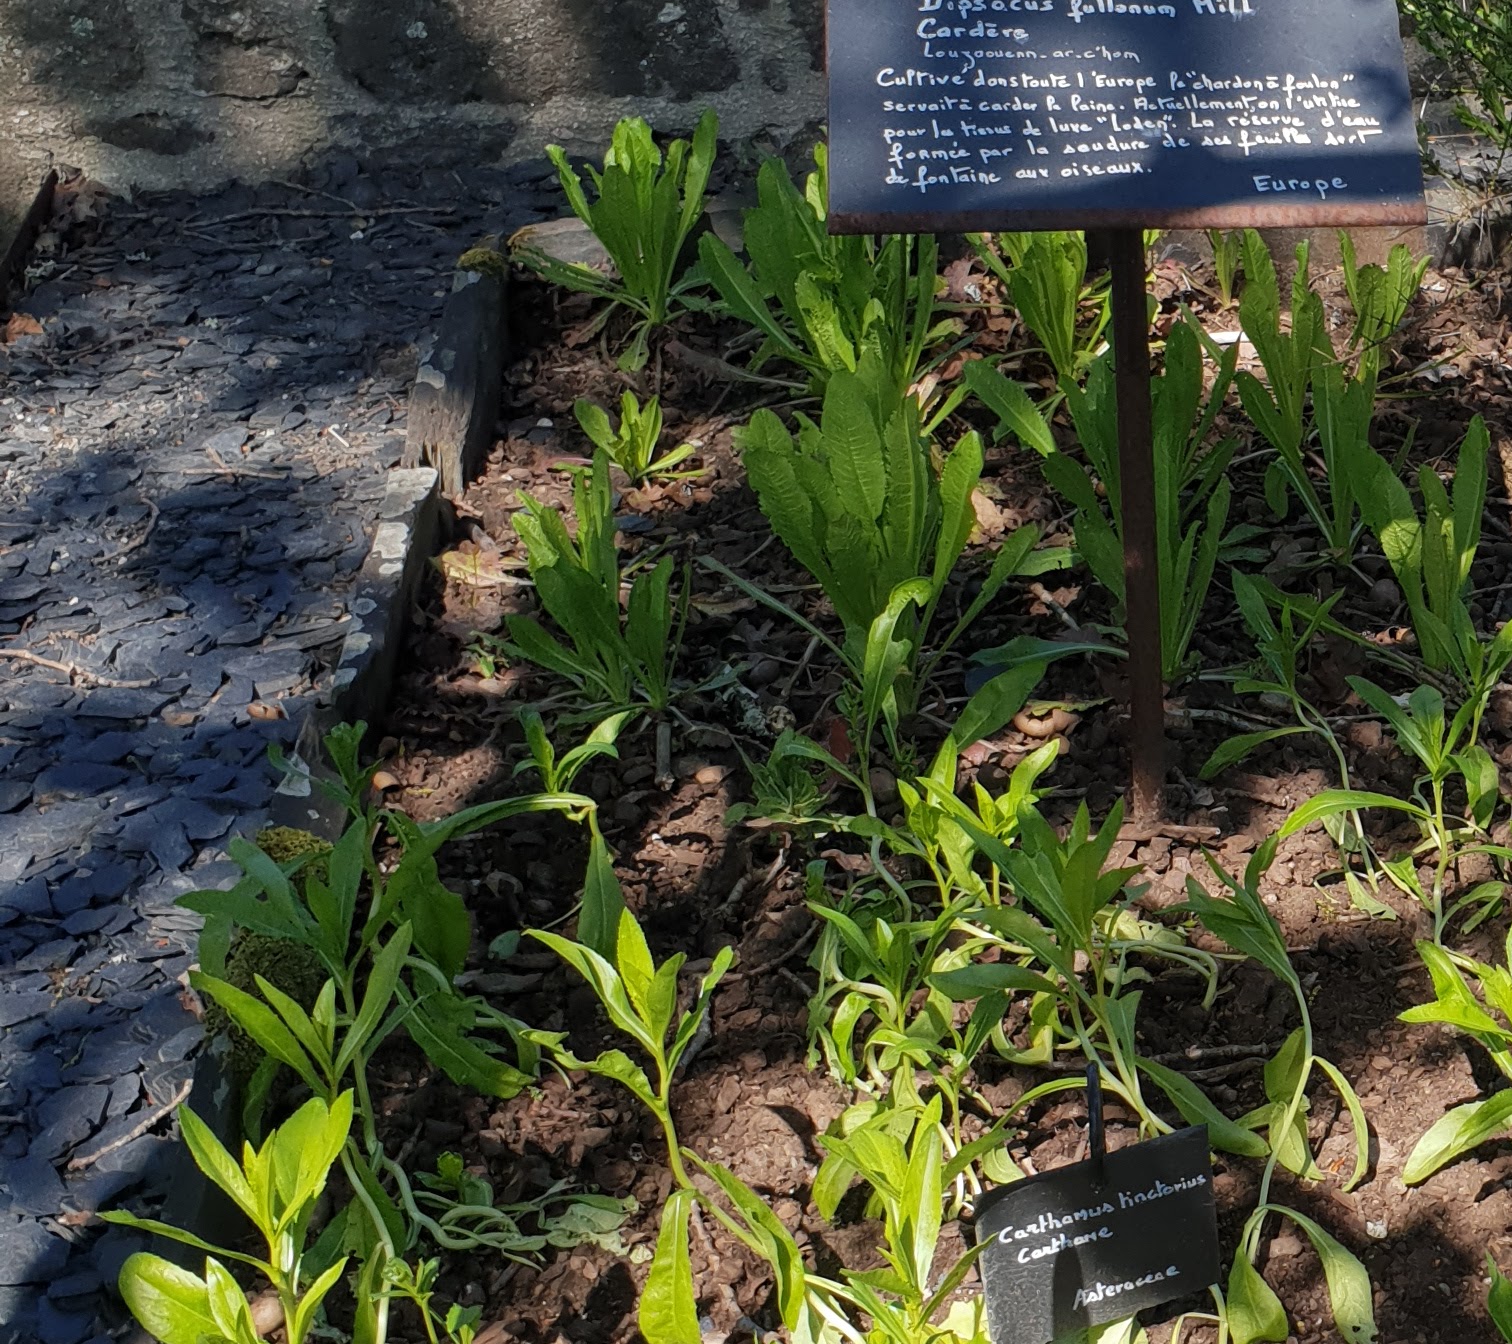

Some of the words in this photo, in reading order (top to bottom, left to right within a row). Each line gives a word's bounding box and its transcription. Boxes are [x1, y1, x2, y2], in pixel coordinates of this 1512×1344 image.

[916, 17, 1029, 40] Cardère
[876, 67, 965, 88] Cultivé
[973, 68, 1019, 88] dans
[1021, 72, 1071, 89] toute
[1077, 70, 1157, 94] l'Europe
[1265, 76, 1279, 90] à
[883, 96, 958, 112] servait
[959, 99, 974, 111] à
[978, 96, 1038, 112] carder
[1257, 99, 1280, 111] on
[883, 127, 926, 144] pour
[960, 120, 1012, 138] tissus
[1022, 119, 1042, 137] de
[1048, 116, 1093, 134] luxe
[1189, 112, 1215, 129] La
[1227, 111, 1305, 128] réserve
[1321, 110, 1380, 128] d'eau
[888, 141, 971, 169] formée
[979, 146, 1014, 164] par
[1027, 138, 1050, 156] la
[1062, 135, 1150, 154] soudure
[1162, 131, 1191, 148] de
[1201, 133, 1232, 147] ses
[885, 168, 909, 186] de
[912, 165, 1002, 193] fontaine
[1015, 167, 1049, 180] aux
[1252, 174, 1348, 199] Europe
[998, 1202, 1115, 1245] Carthamus
[1117, 1172, 1208, 1210] tinctorius
[1072, 1264, 1181, 1312] Asteraceae
